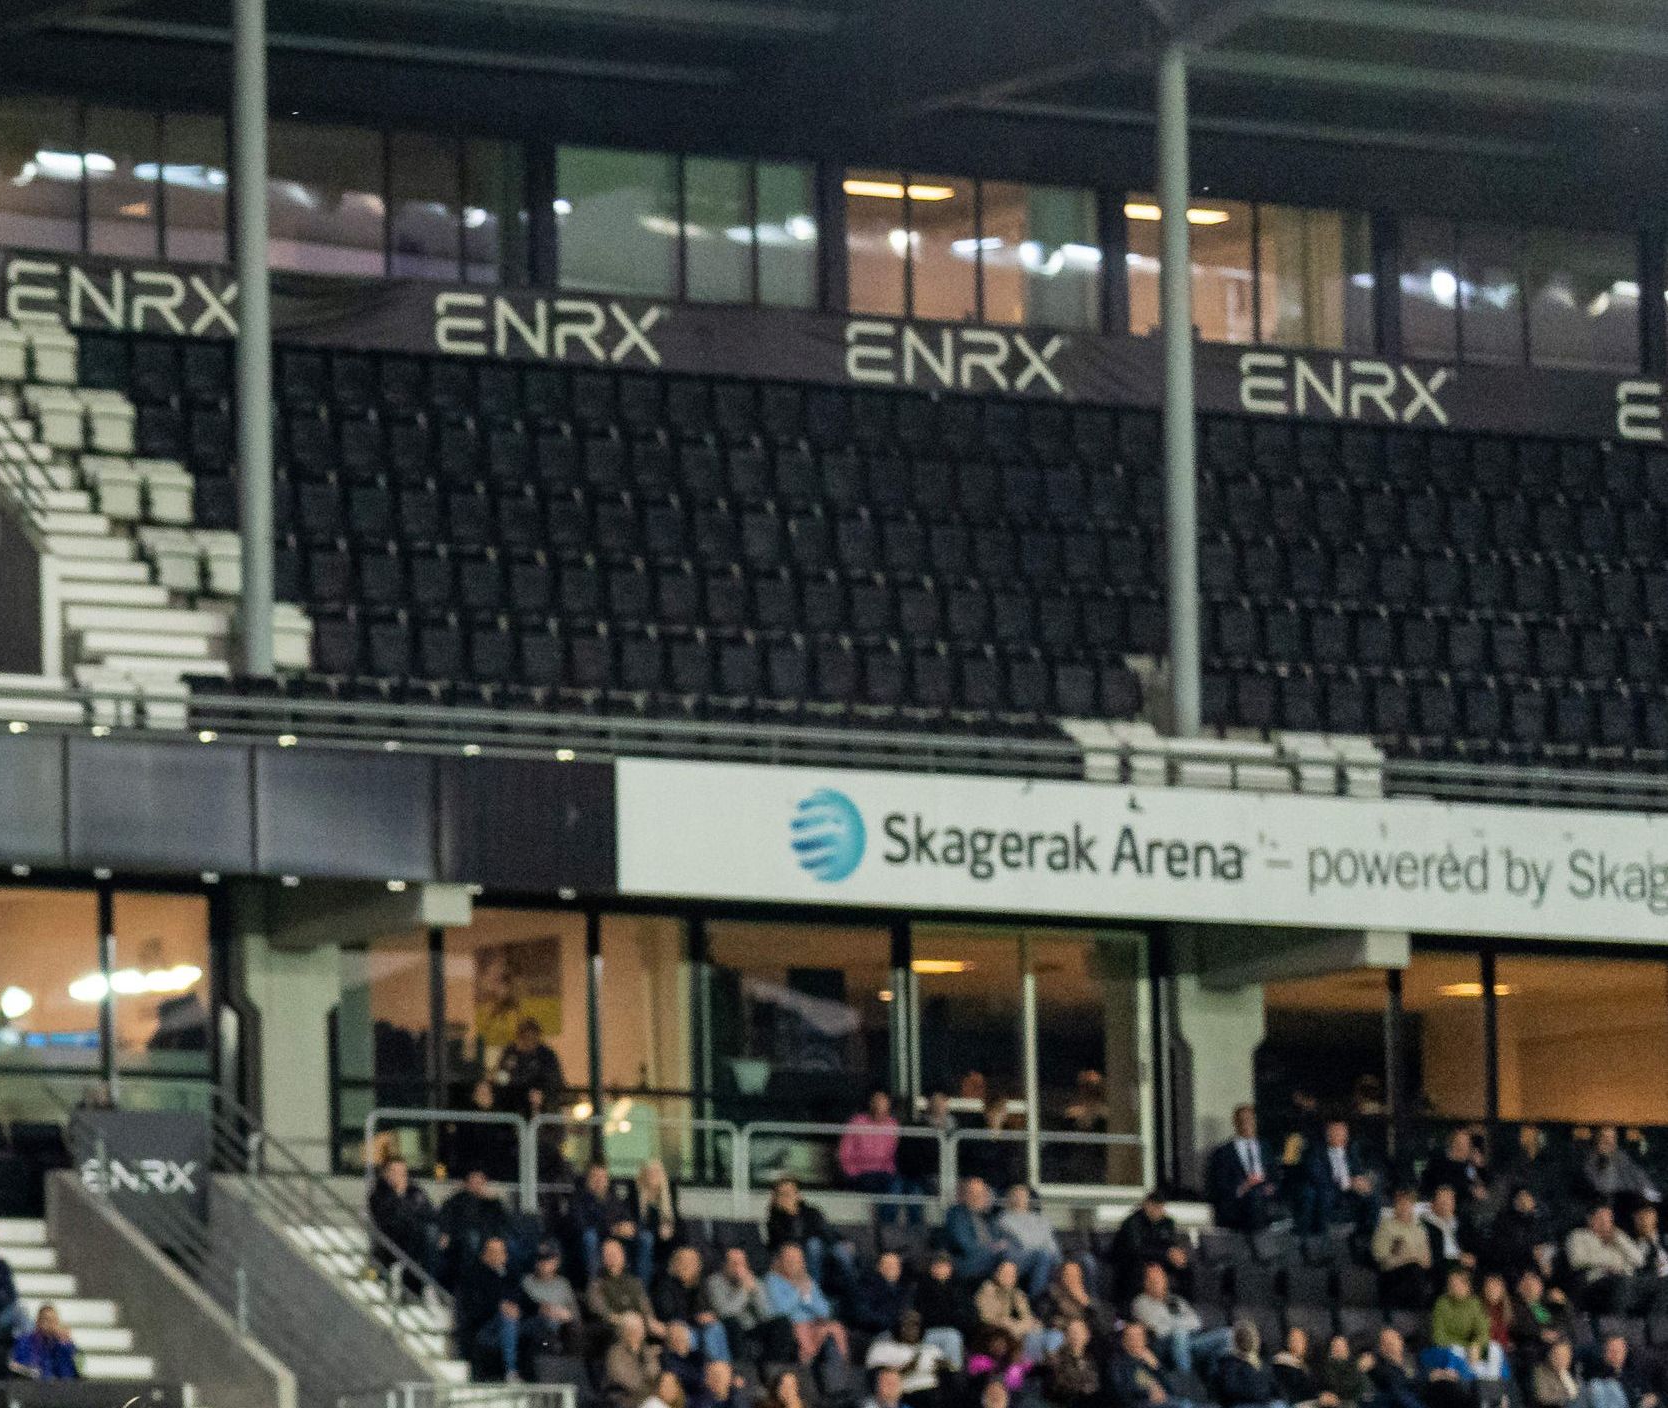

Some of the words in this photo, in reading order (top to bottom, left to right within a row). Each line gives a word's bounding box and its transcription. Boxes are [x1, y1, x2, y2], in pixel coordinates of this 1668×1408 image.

[6, 258, 238, 336] ENRX
[435, 292, 663, 367] ENRX
[845, 321, 1063, 393] ENRX
[1239, 352, 1449, 426] ENRX
[882, 812, 1099, 881] Skagerak
[1112, 824, 1245, 881] Arena
[1308, 844, 1490, 896] powered
[1505, 848, 1553, 909] by
